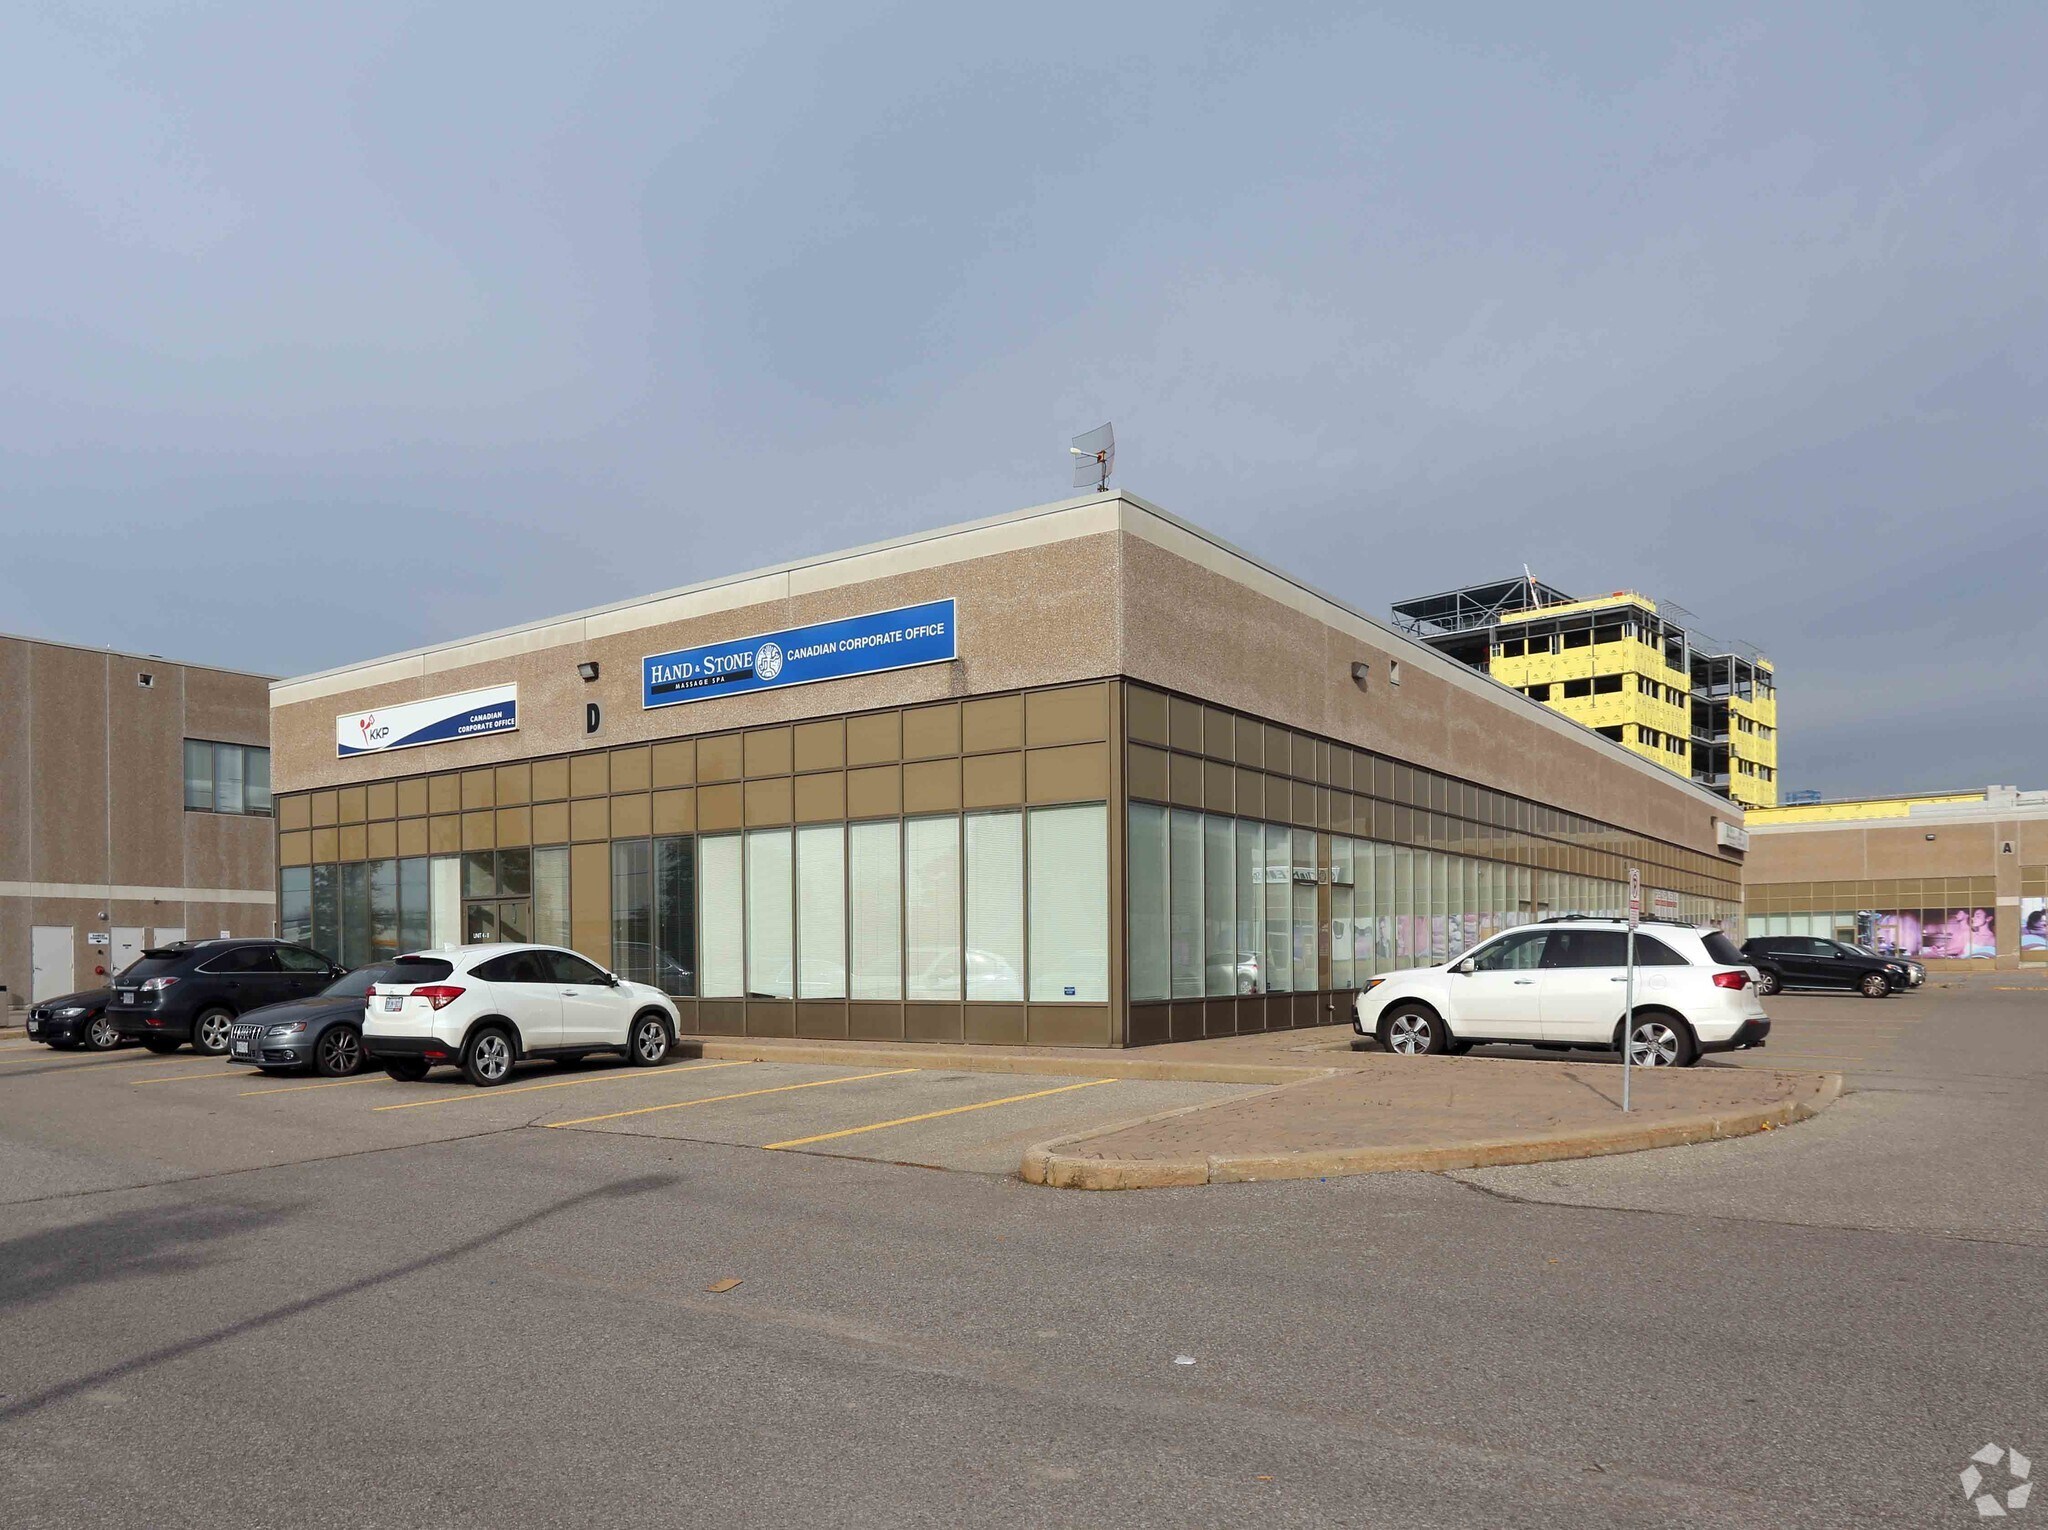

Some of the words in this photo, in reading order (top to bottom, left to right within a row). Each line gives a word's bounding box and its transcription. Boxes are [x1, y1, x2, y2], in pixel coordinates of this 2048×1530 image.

[787, 642, 837, 661] CANADIAN
[839, 630, 902, 651] CORPORATE
[905, 623, 945, 641] OFFICE
[651, 662, 693, 684] HAND
[695, 664, 700, 673] &
[703, 651, 753, 675] STONE
[675, 678, 708, 690] MASSAGE
[712, 676, 725, 684] SPA
[470, 711, 503, 723] CANADIAN
[586, 703, 600, 733] D
[369, 726, 390, 741] KKP
[458, 721, 493, 734] CORPORATE
[494, 717, 515, 727] OFFICE
[2003, 842, 2012, 853] A
